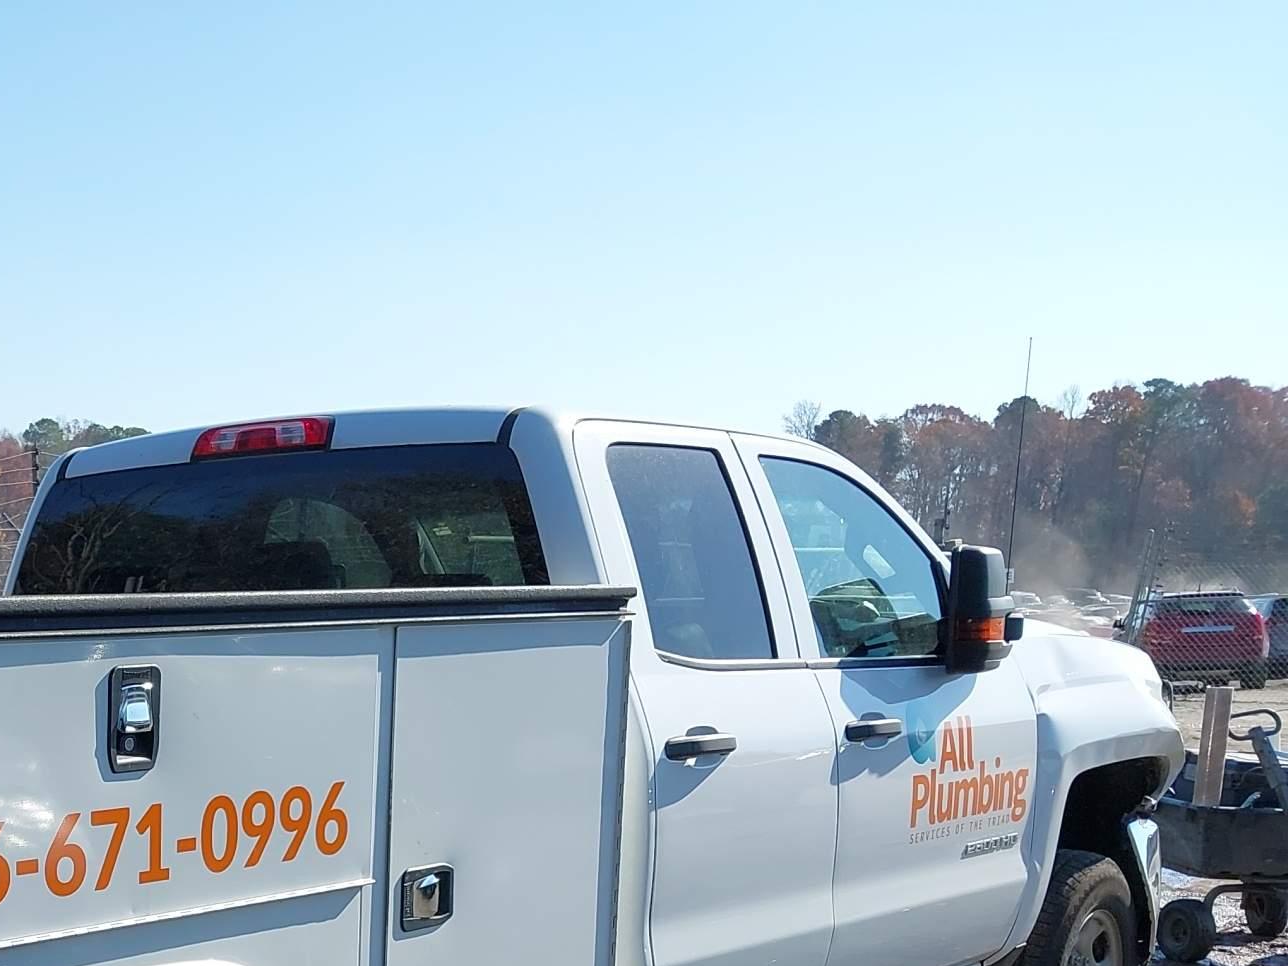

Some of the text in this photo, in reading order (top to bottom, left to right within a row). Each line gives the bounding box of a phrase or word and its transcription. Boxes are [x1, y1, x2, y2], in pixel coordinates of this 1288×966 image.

[939, 715, 974, 774] All
[910, 757, 1029, 829] Plumbing
[909, 826, 951, 845] SERVICES
[955, 822, 964, 834] OF
[969, 820, 983, 832] THE
